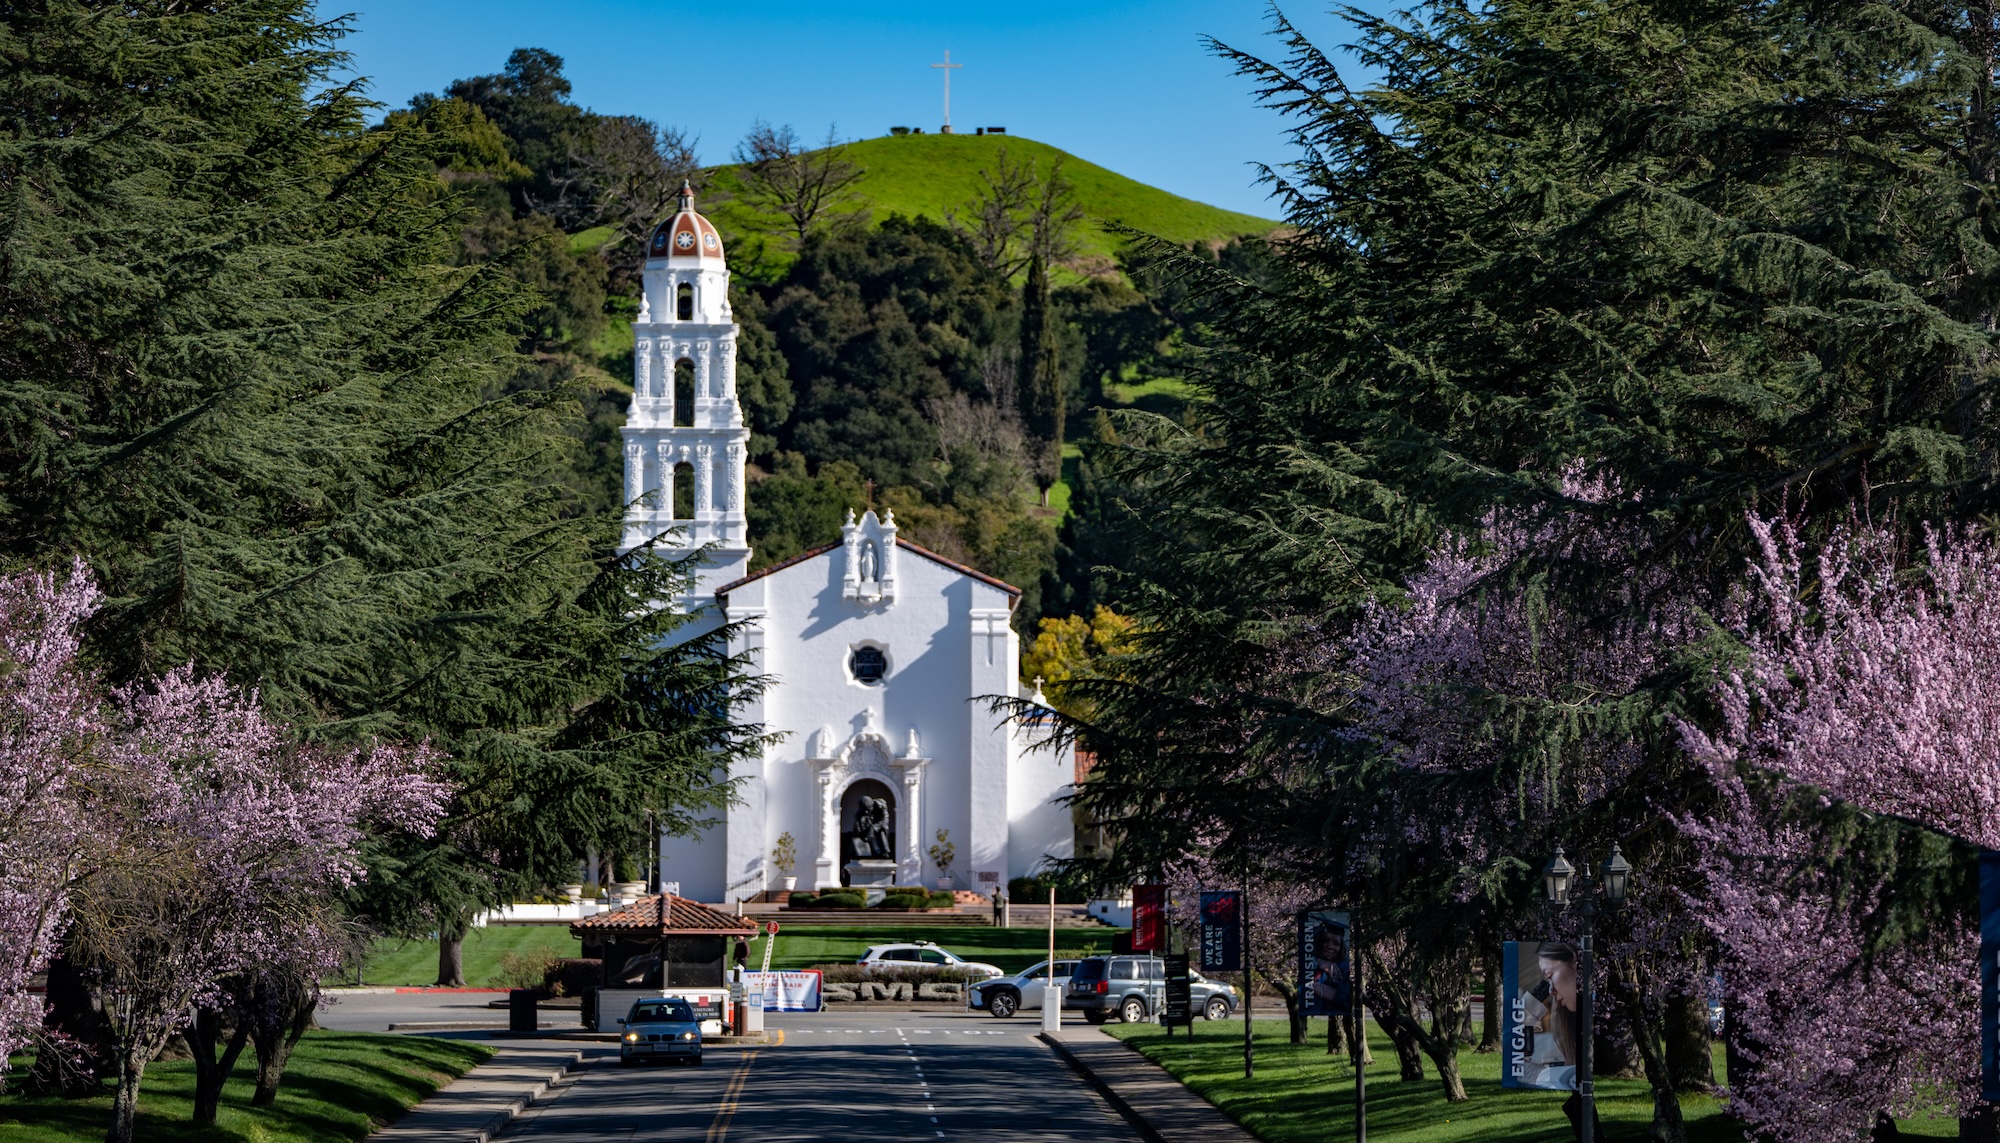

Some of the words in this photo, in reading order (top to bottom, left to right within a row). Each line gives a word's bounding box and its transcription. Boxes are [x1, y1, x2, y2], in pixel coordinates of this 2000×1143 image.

[1205, 924, 1213, 947] ARE
[1215, 927, 1223, 966] GAELS!
[1205, 949, 1213, 966] WE
[1304, 921, 1315, 1009] TRANSFORM
[822, 982, 962, 1002] SMC
[1511, 997, 1526, 1077] ENGAGE
